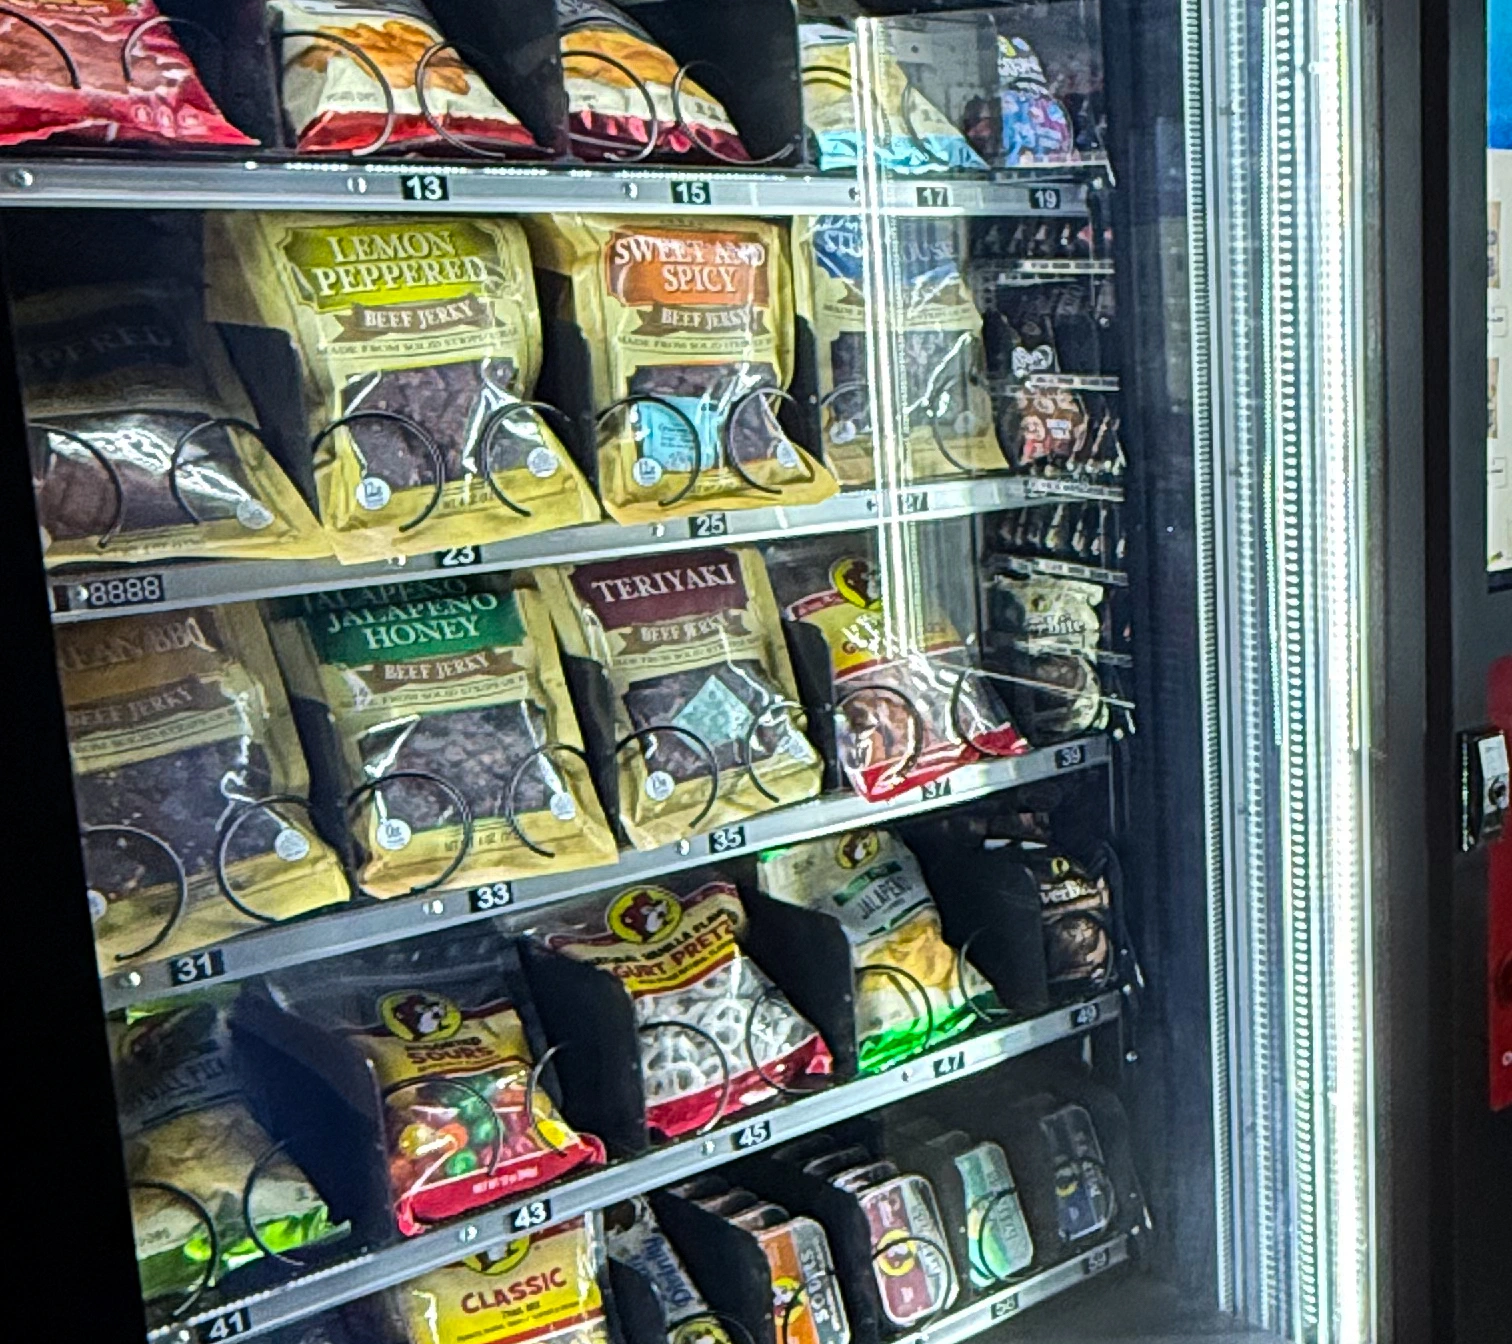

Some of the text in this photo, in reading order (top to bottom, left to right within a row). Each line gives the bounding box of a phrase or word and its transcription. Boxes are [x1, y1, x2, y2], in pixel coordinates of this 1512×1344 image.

[406, 175, 443, 201] 13
[674, 181, 709, 205] 15
[921, 185, 949, 208] 17
[1033, 188, 1059, 211] 19
[327, 229, 456, 264] LEMON
[614, 236, 766, 268] SWEET AND
[311, 255, 489, 297] PEPPERED
[661, 264, 739, 294] SPICY
[363, 299, 476, 330] BEEF JERKY
[661, 307, 702, 329] BEEF
[696, 515, 725, 536] 25
[443, 543, 477, 566] 23
[591, 562, 737, 604] TERIYAKI
[363, 615, 481, 651] HONEY
[640, 614, 730, 642] BEEF JERKY
[383, 654, 490, 681] BEEF JERKY
[127, 687, 193, 722] JERKY
[1060, 747, 1083, 768] 39
[924, 781, 950, 800] 37
[712, 826, 744, 851] 35
[476, 882, 511, 910] 33
[175, 952, 213, 985] 31
[1075, 1005, 1097, 1024] 49
[937, 1054, 966, 1073] 47
[737, 1121, 769, 1147] 45
[513, 1202, 547, 1229] 43
[1085, 1248, 1109, 1272] 59
[460, 1266, 568, 1314] CLASSIC
[993, 1293, 1018, 1315] 58
[208, 1310, 246, 1341] 41
